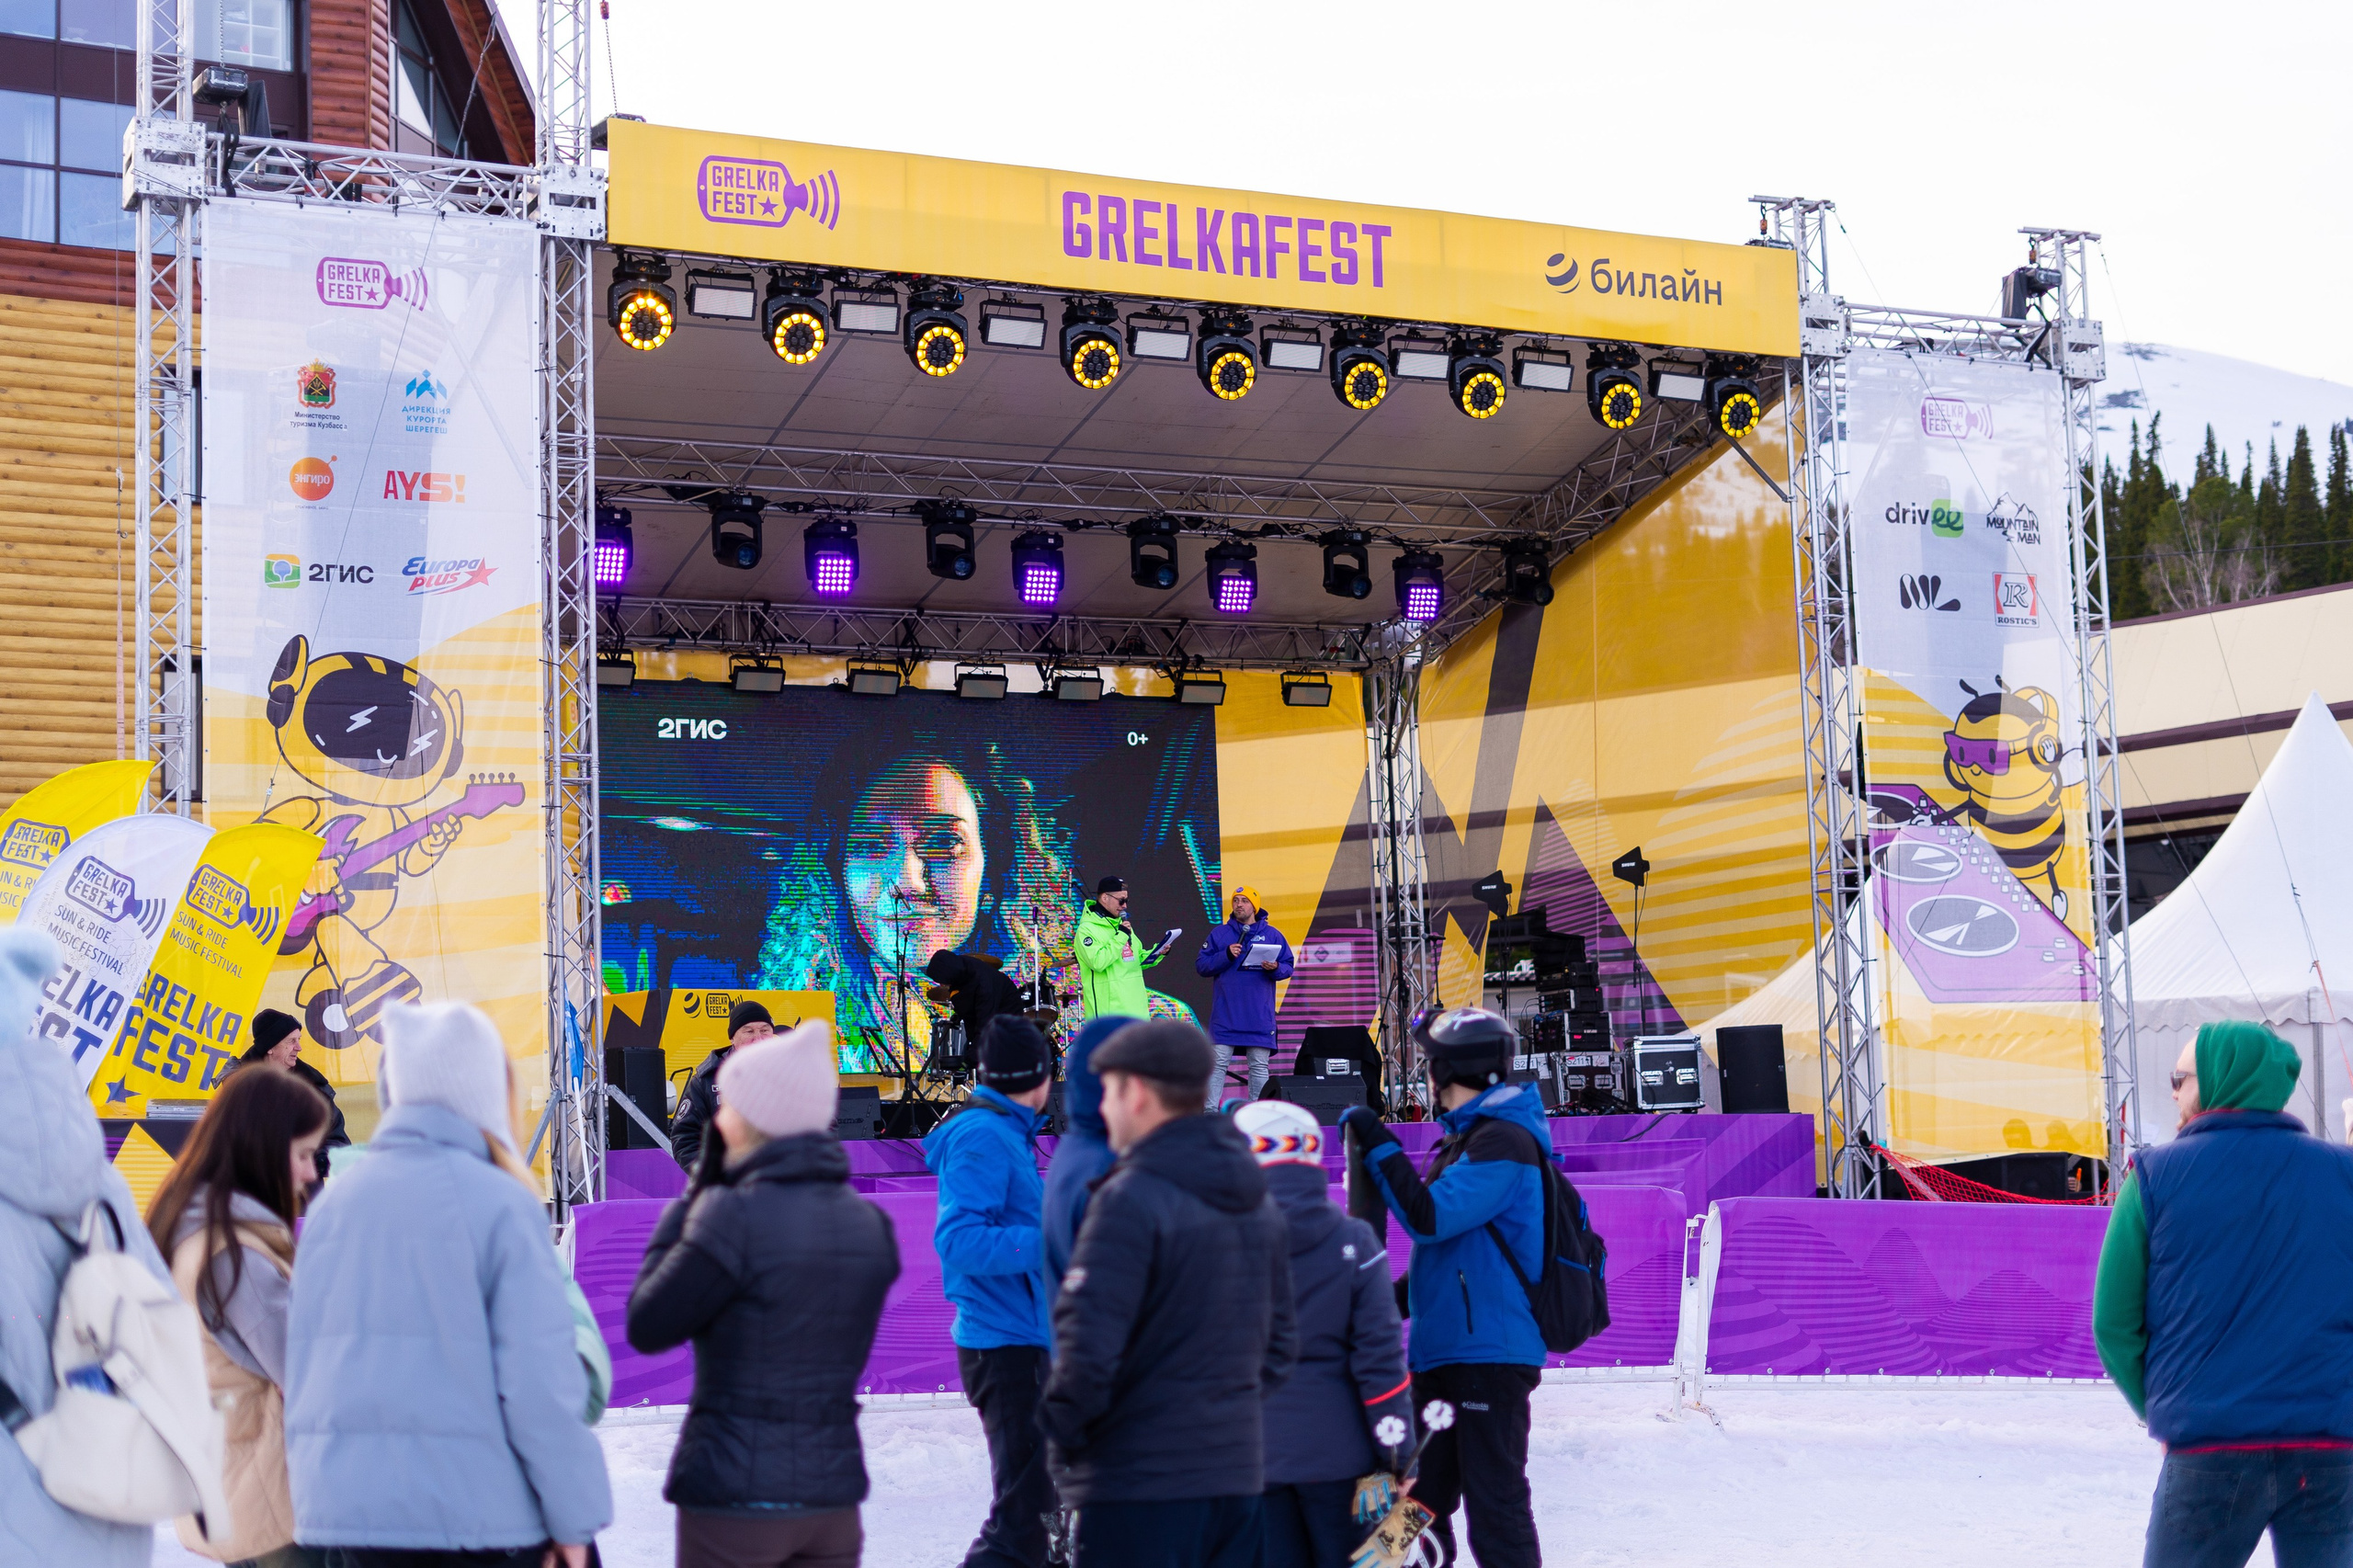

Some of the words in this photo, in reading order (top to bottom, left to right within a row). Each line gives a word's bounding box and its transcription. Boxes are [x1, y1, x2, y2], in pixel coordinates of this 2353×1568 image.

[712, 165, 779, 192] GRELKA
[712, 191, 757, 216] FEST
[1062, 190, 1392, 289] GRELKAFEST
[327, 264, 381, 284] GRELKA
[1590, 258, 1723, 306] билайн
[328, 283, 364, 301] FEST
[294, 411, 340, 421] Министерство
[402, 405, 451, 415] ДИРЕКЦИЯ
[406, 415, 448, 425] КУРОРТА
[1928, 403, 1964, 417] GRELKA
[290, 420, 316, 430] туризма
[317, 420, 347, 430] Кузбасса
[405, 425, 448, 435] ШЕРЕГЕШ
[1928, 418, 1952, 432] FEST
[294, 473, 331, 486] энгиро
[383, 470, 466, 504] AYS!
[1885, 502, 1964, 531] drivee
[309, 563, 374, 585] 2ГИС
[1997, 616, 2038, 626] ROSTIC'S
[658, 718, 727, 740] 2ГИС
[1127, 732, 1149, 746] 0+
[13, 825, 62, 847] GRELKA
[7, 842, 40, 860] FEST
[82, 863, 130, 899] GRELKA
[200, 871, 244, 905] GRELKA
[73, 880, 108, 907] FEST
[192, 889, 223, 913] FEST
[54, 904, 77, 926] SUN
[76, 918, 86, 933] &
[85, 920, 112, 945] RIDE
[176, 911, 197, 931] SUN
[197, 924, 204, 937] &
[205, 926, 229, 949] RIDE
[47, 922, 79, 950] MUSIC
[78, 939, 125, 976] FESTIVAL
[169, 927, 200, 956] MUSIC
[199, 949, 243, 979] FESTIVAL
[41, 963, 125, 1032] ELKA
[709, 996, 728, 1006] GRELKA
[710, 1006, 723, 1015] FEST
[1514, 1061, 1536, 1070] S21
